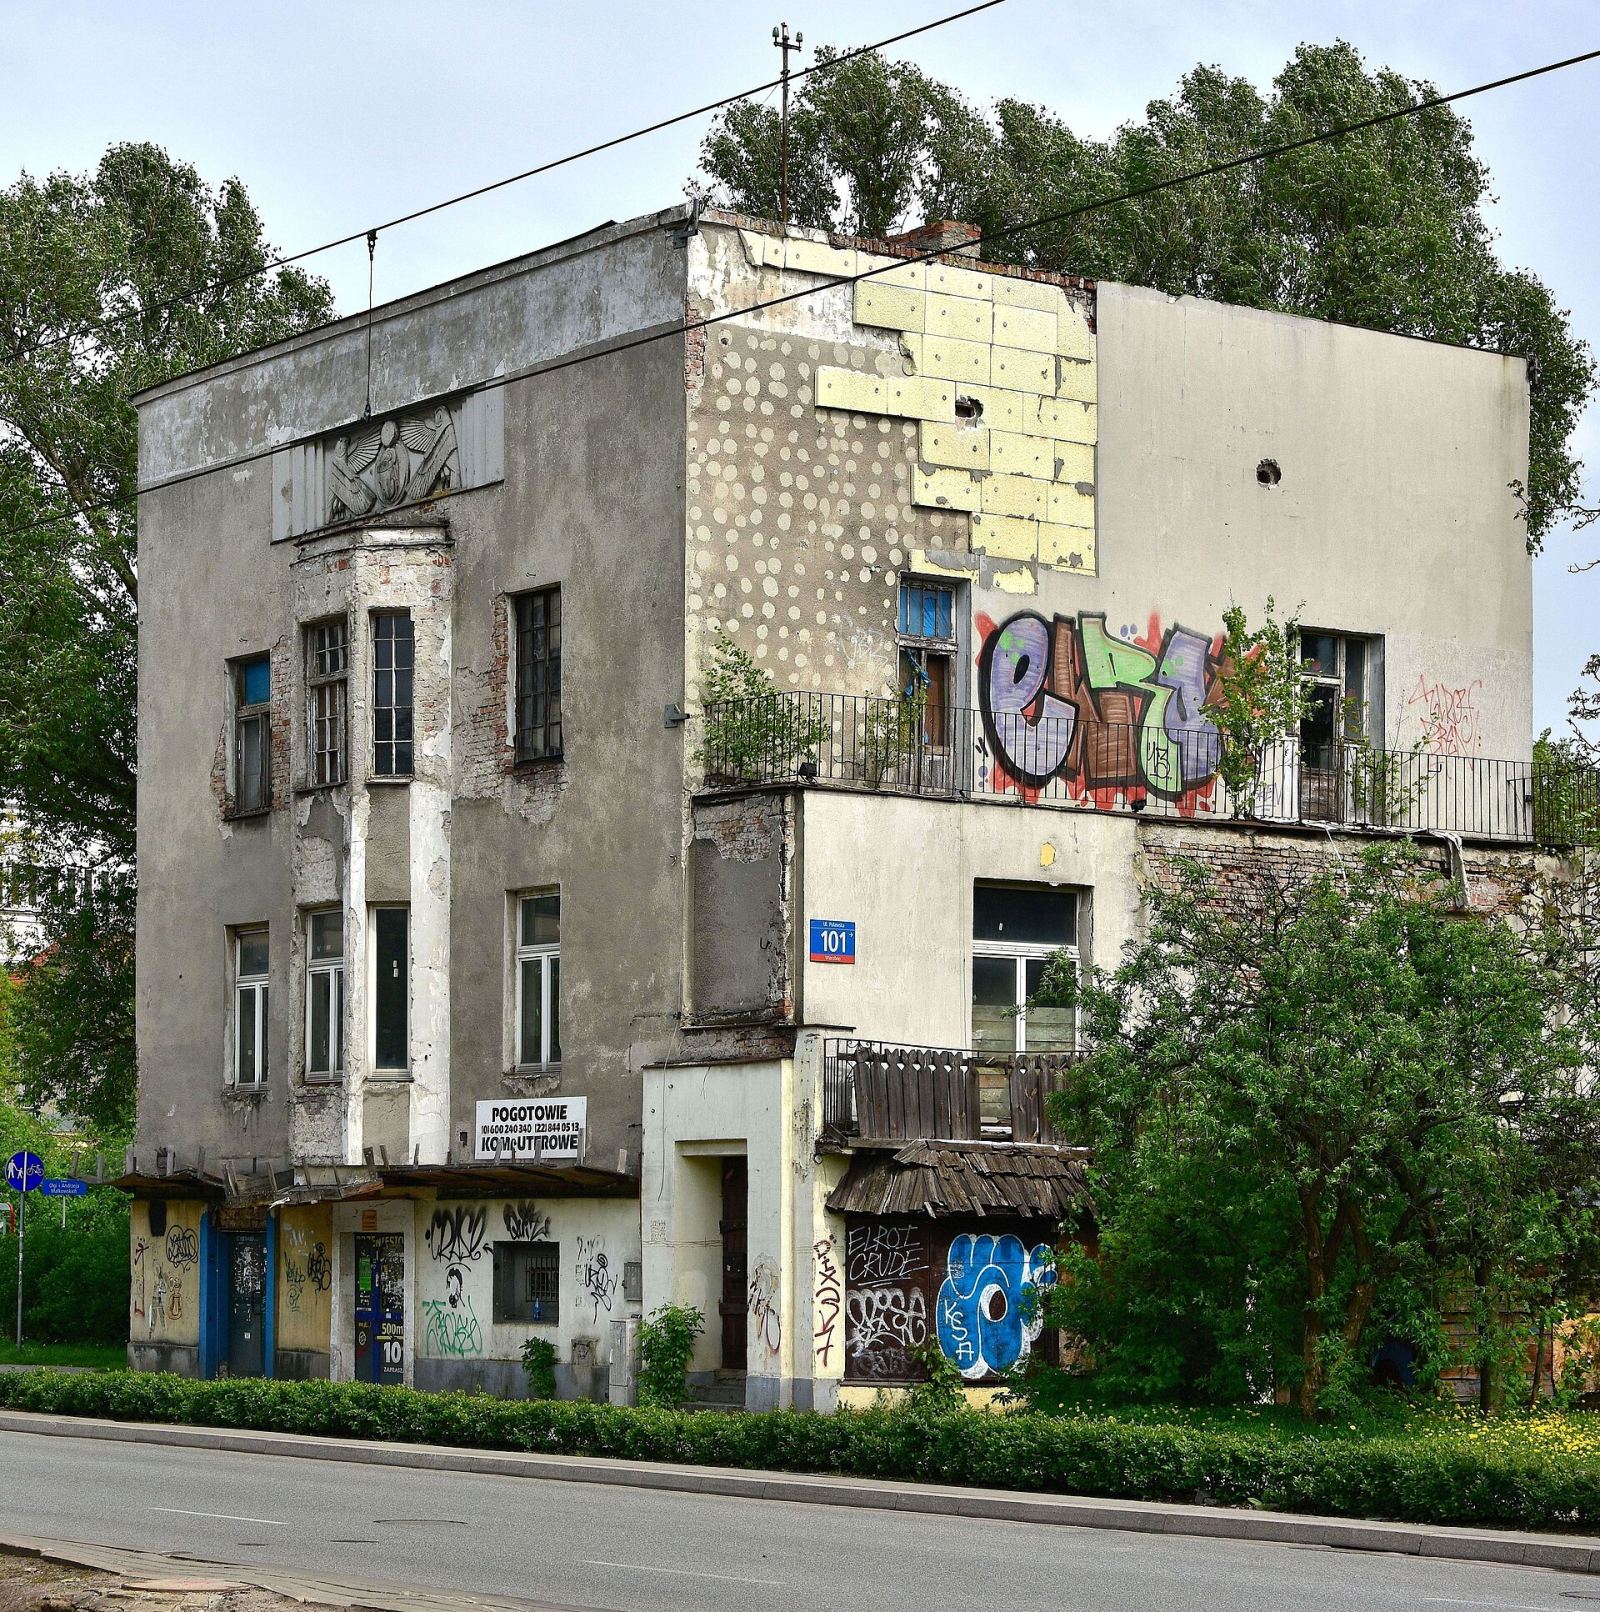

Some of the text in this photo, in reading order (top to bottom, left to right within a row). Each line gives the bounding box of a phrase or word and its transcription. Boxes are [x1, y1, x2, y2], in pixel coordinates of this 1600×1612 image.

[821, 930, 846, 953] 101
[492, 1105, 567, 1122] POGOTOWIE
[504, 1124, 518, 1134] 240
[519, 1123, 532, 1134] 340
[850, 1247, 929, 1281] CRUDE
